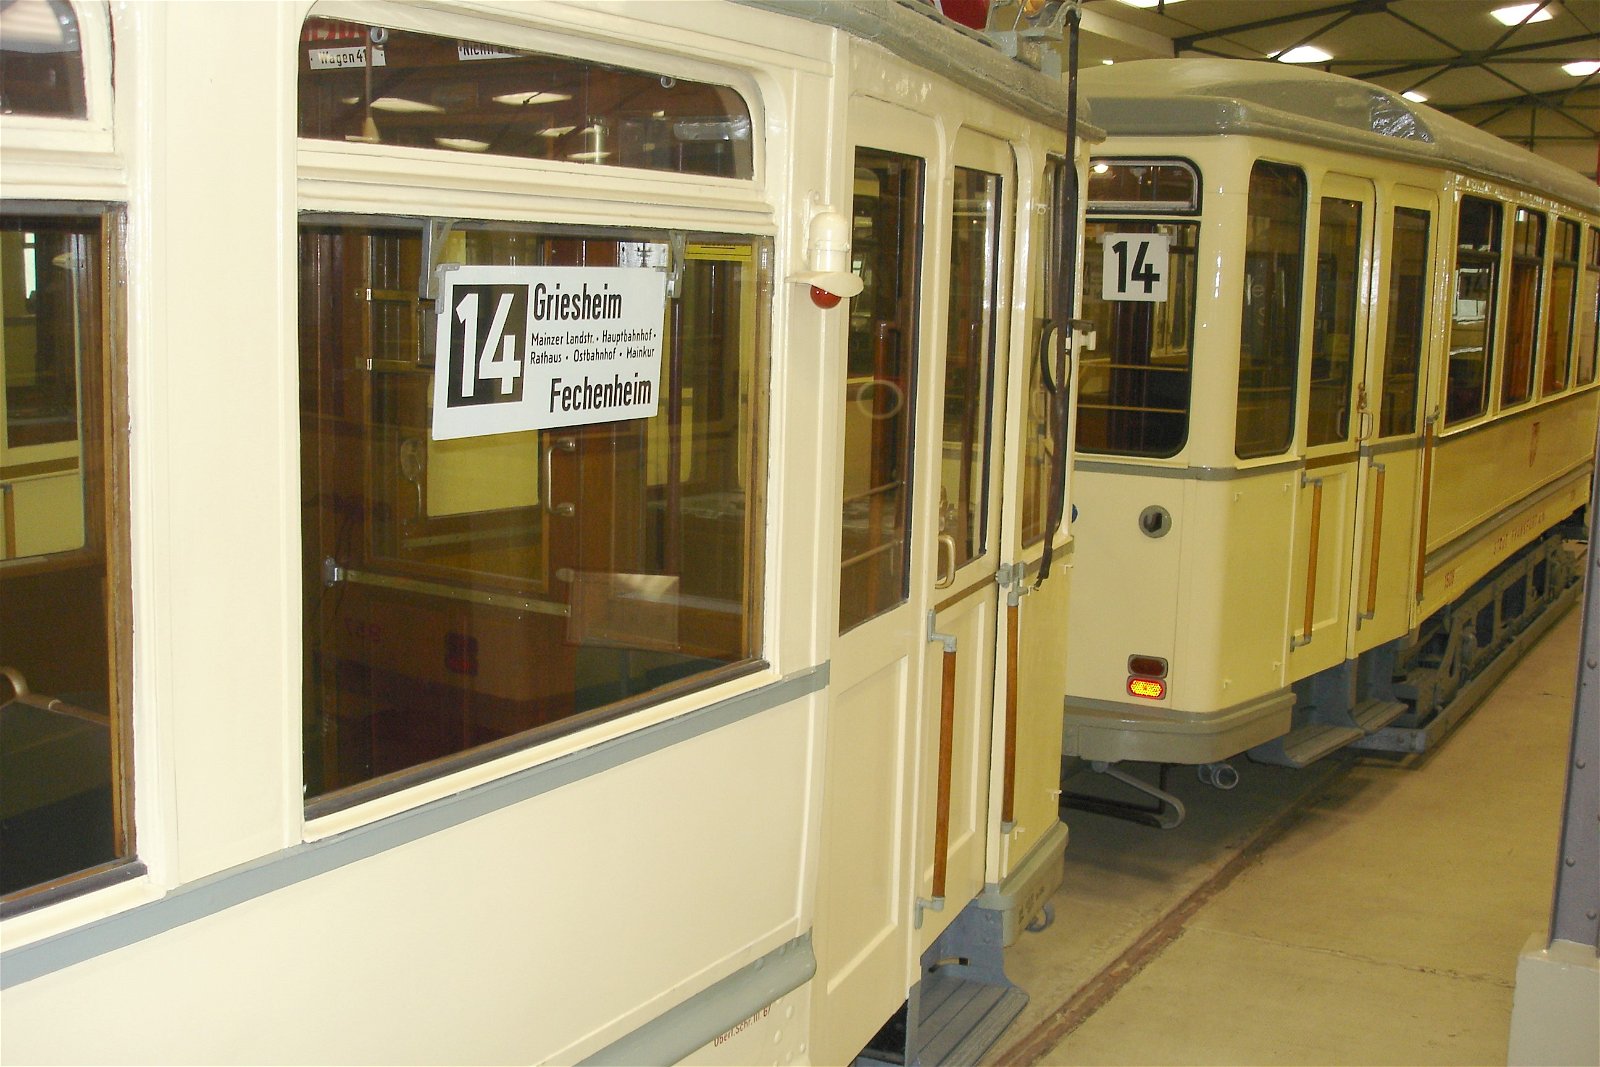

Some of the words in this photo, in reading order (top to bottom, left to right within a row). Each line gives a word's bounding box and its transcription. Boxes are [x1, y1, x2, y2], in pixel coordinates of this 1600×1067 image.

[1112, 241, 1160, 294] 14
[533, 282, 622, 321] Griesheim
[455, 292, 522, 398] 14
[530, 350, 562, 365] Rathaus
[573, 347, 617, 363] Ostbahnhof
[626, 346, 655, 359] Mainkur
[531, 331, 564, 346] Mainzer
[566, 330, 595, 345] Landstr.
[602, 328, 652, 346] Hauptbahnhof
[550, 372, 652, 413] Fechenheim
